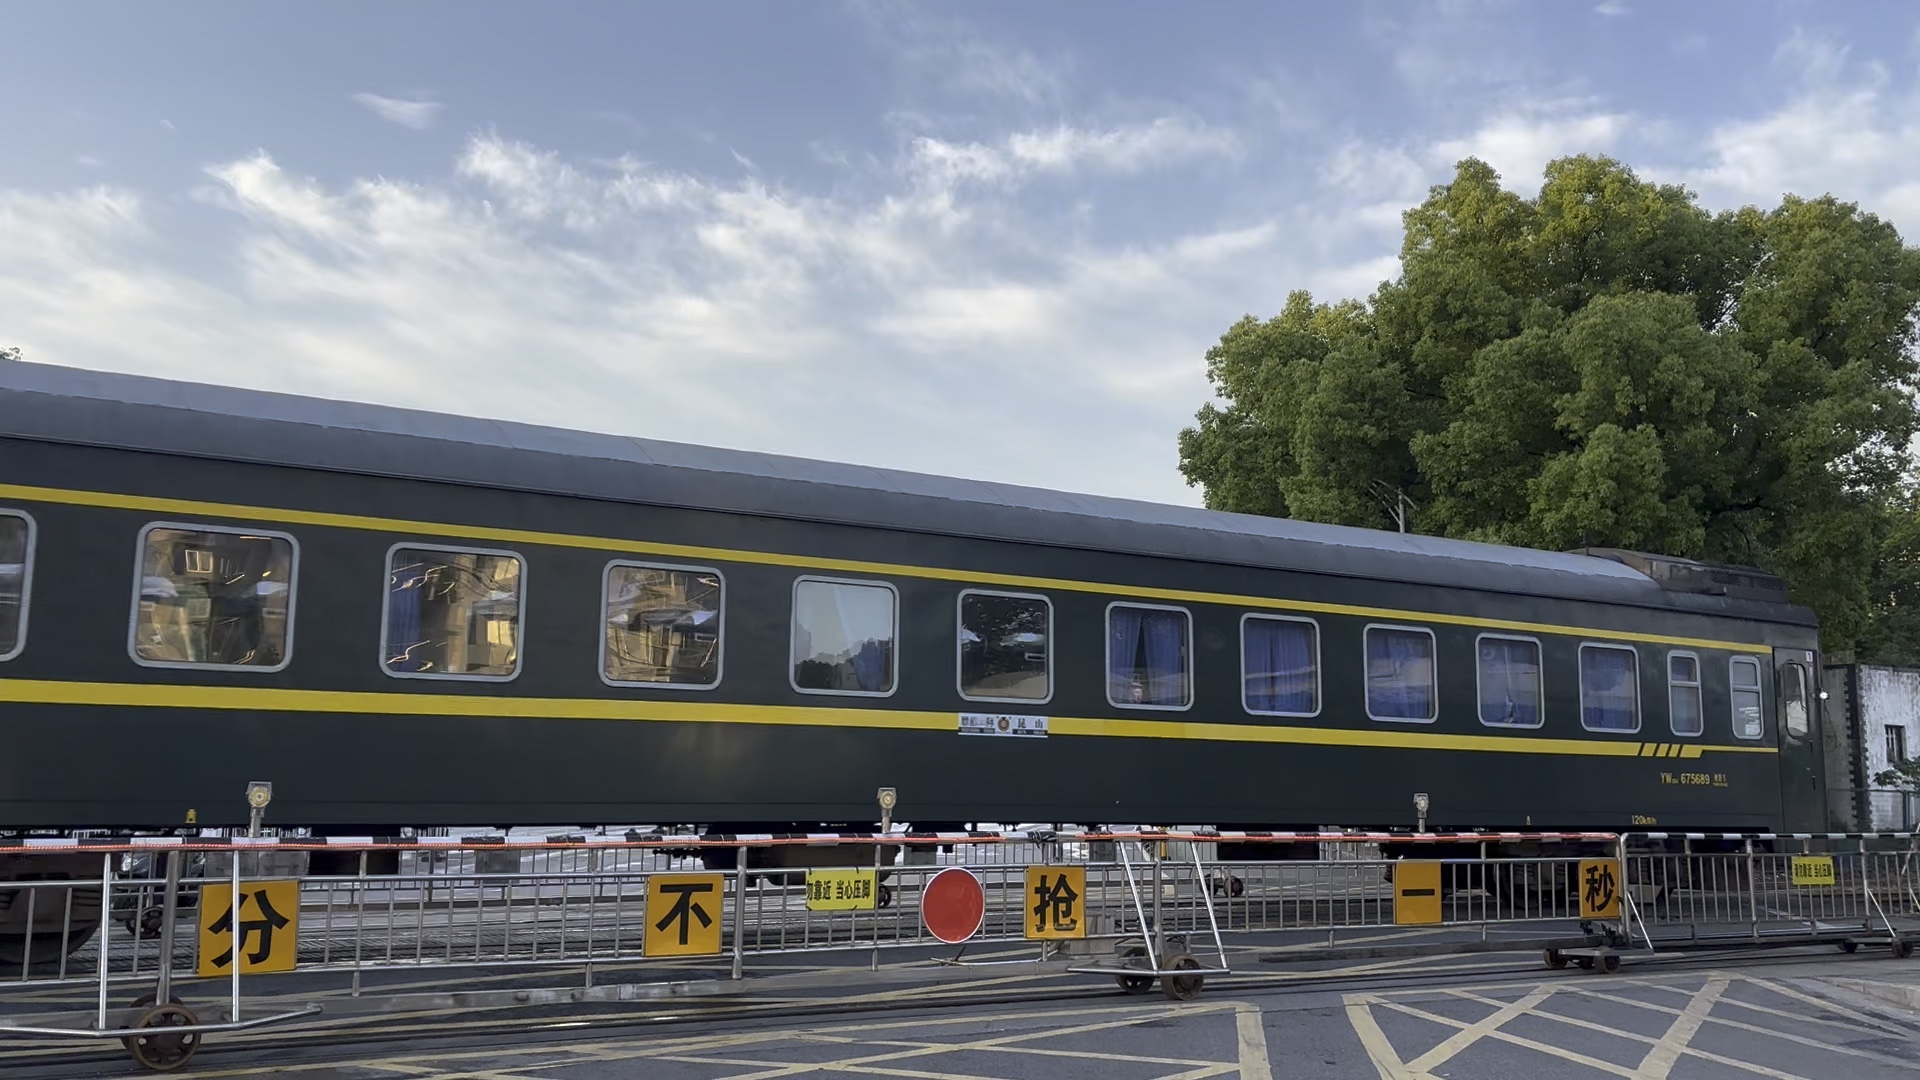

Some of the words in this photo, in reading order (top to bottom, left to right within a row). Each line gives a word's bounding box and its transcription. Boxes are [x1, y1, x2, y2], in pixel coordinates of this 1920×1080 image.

[1681, 773, 1710, 785] 675689
[656, 883, 713, 945] 不
[1033, 873, 1078, 932] 抢
[1402, 888, 1435, 897] 一
[1585, 864, 1615, 912] 秒
[208, 889, 290, 968] 分
